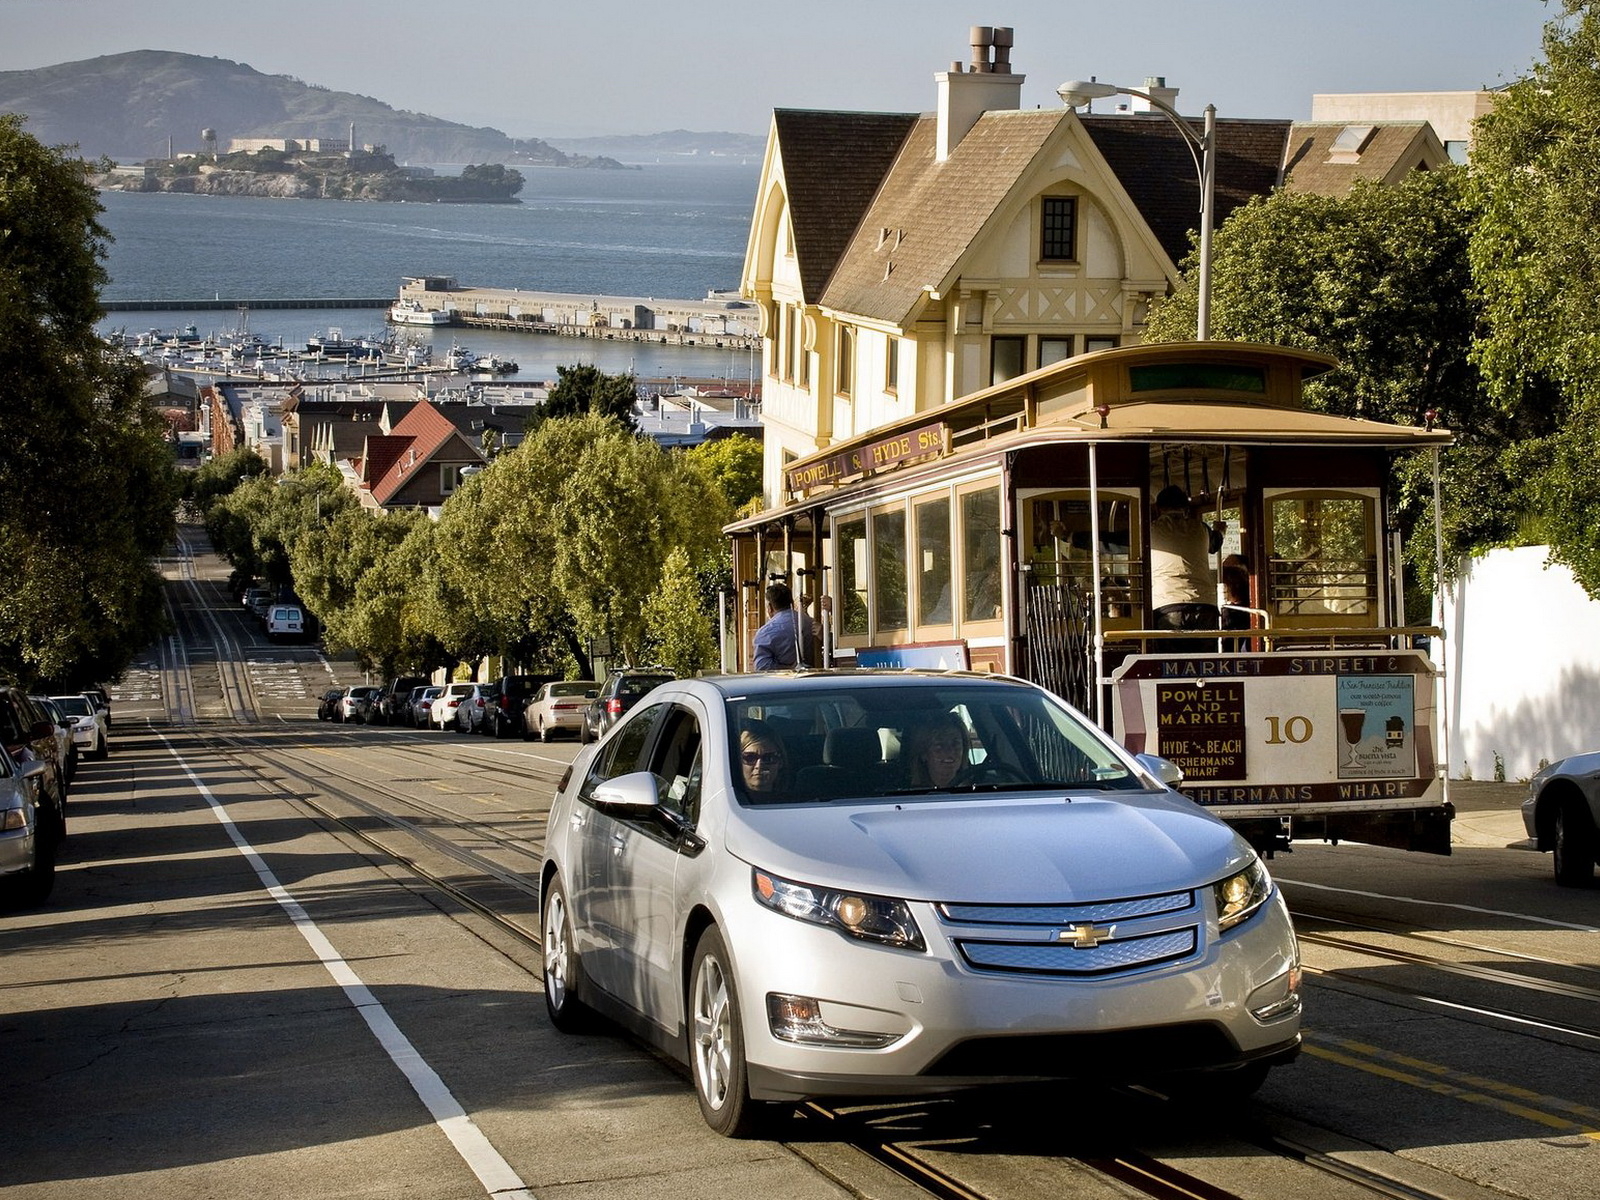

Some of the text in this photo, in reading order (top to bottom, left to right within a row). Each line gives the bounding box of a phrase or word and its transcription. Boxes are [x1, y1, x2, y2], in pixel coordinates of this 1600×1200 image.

[795, 461, 841, 486] POWELL
[852, 454, 862, 470] &
[873, 437, 911, 463] HYDE
[1164, 660, 1264, 675] MARKET
[1290, 657, 1378, 673] STREET
[1358, 681, 1385, 690] Francisco
[1162, 689, 1239, 702] POWELL
[1183, 702, 1221, 712] AND
[1161, 712, 1240, 725] MARKET
[1264, 715, 1313, 745] 10
[1162, 739, 1242, 754] HYDE AND BEACH
[1170, 756, 1235, 767] FISHERMANS
[1185, 766, 1219, 777] WHARF
[1182, 781, 1409, 802] SHERMANS WHARF
